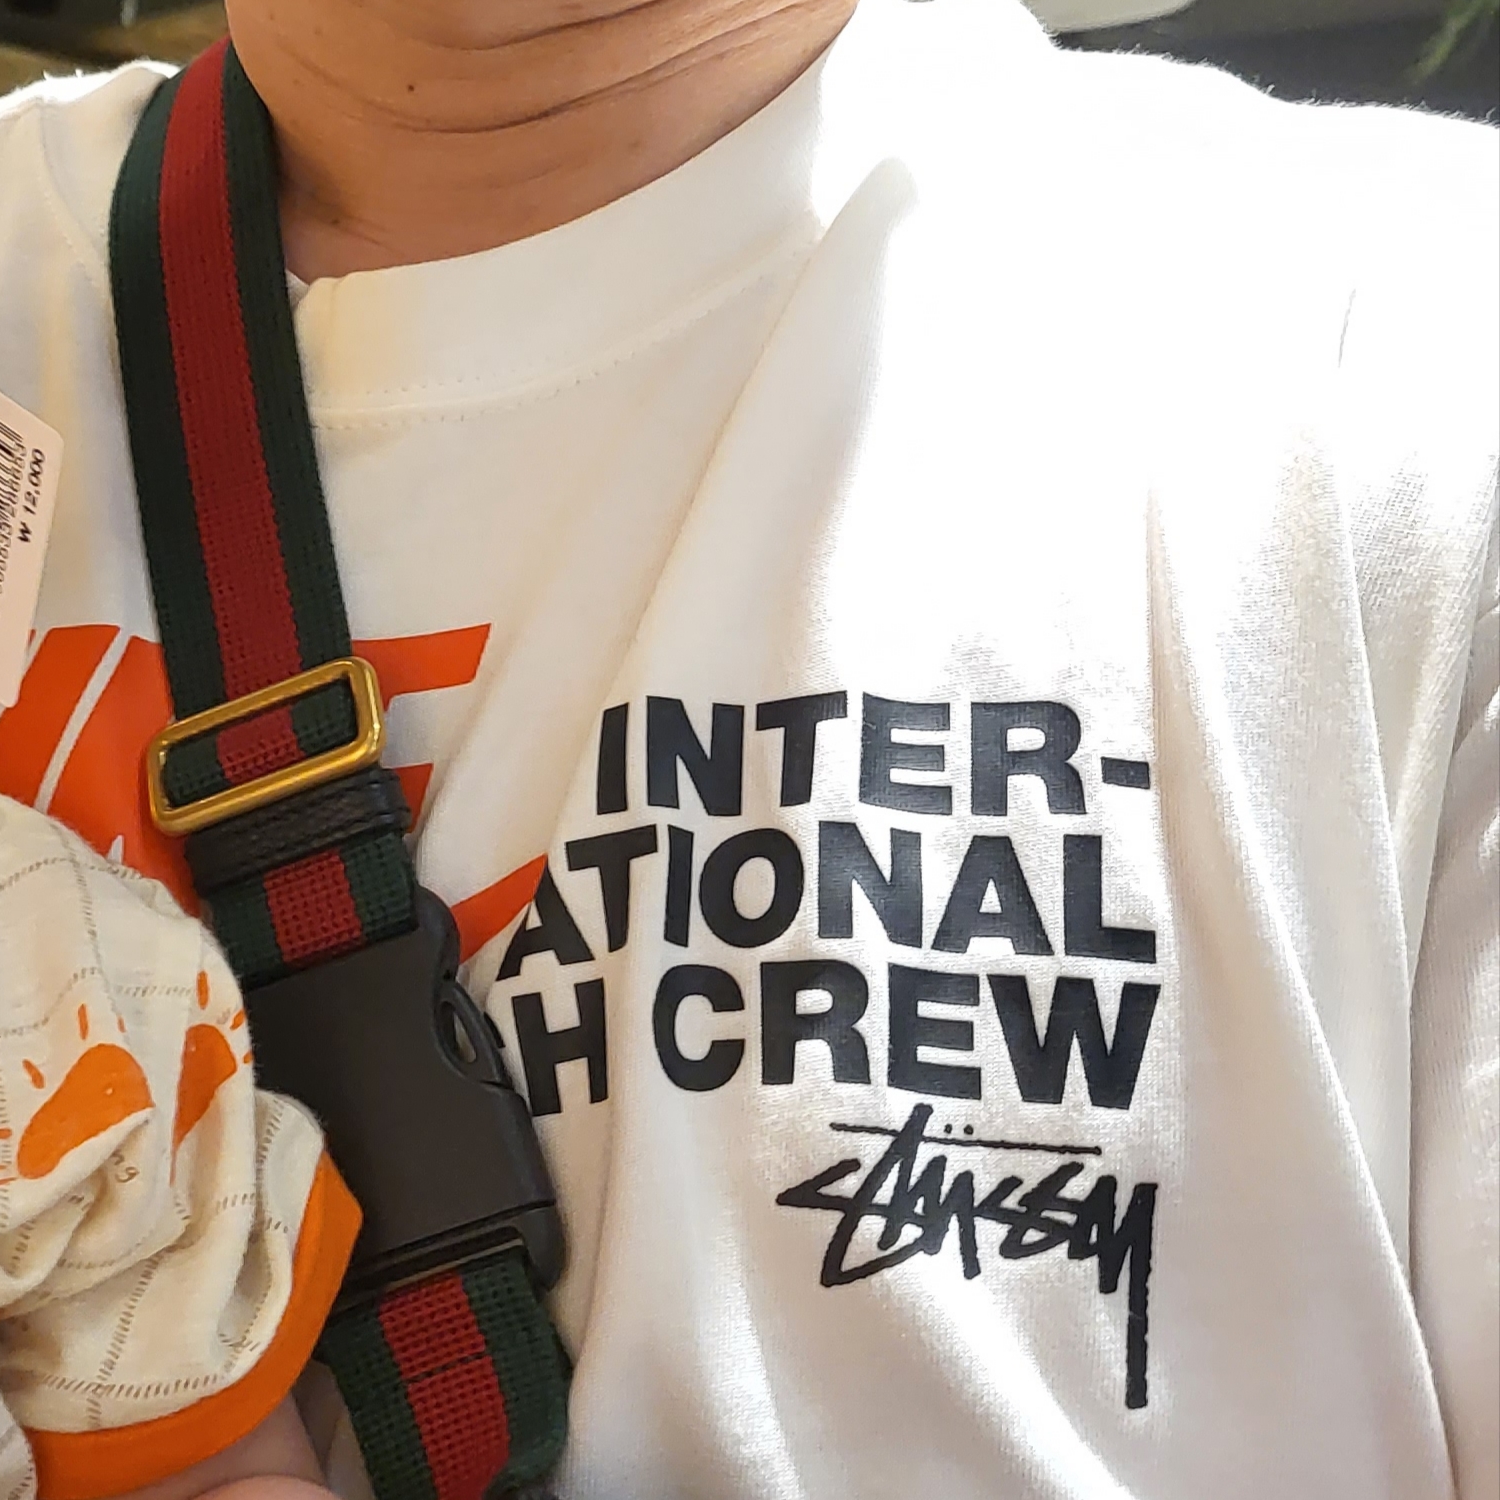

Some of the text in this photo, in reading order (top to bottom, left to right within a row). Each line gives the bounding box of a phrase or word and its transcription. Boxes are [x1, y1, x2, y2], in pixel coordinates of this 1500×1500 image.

[22, 448, 45, 516] 12,000
[597, 690, 1150, 816] INTER-
[497, 820, 1157, 982] ATIONAL
[652, 958, 1161, 1111] CREW
